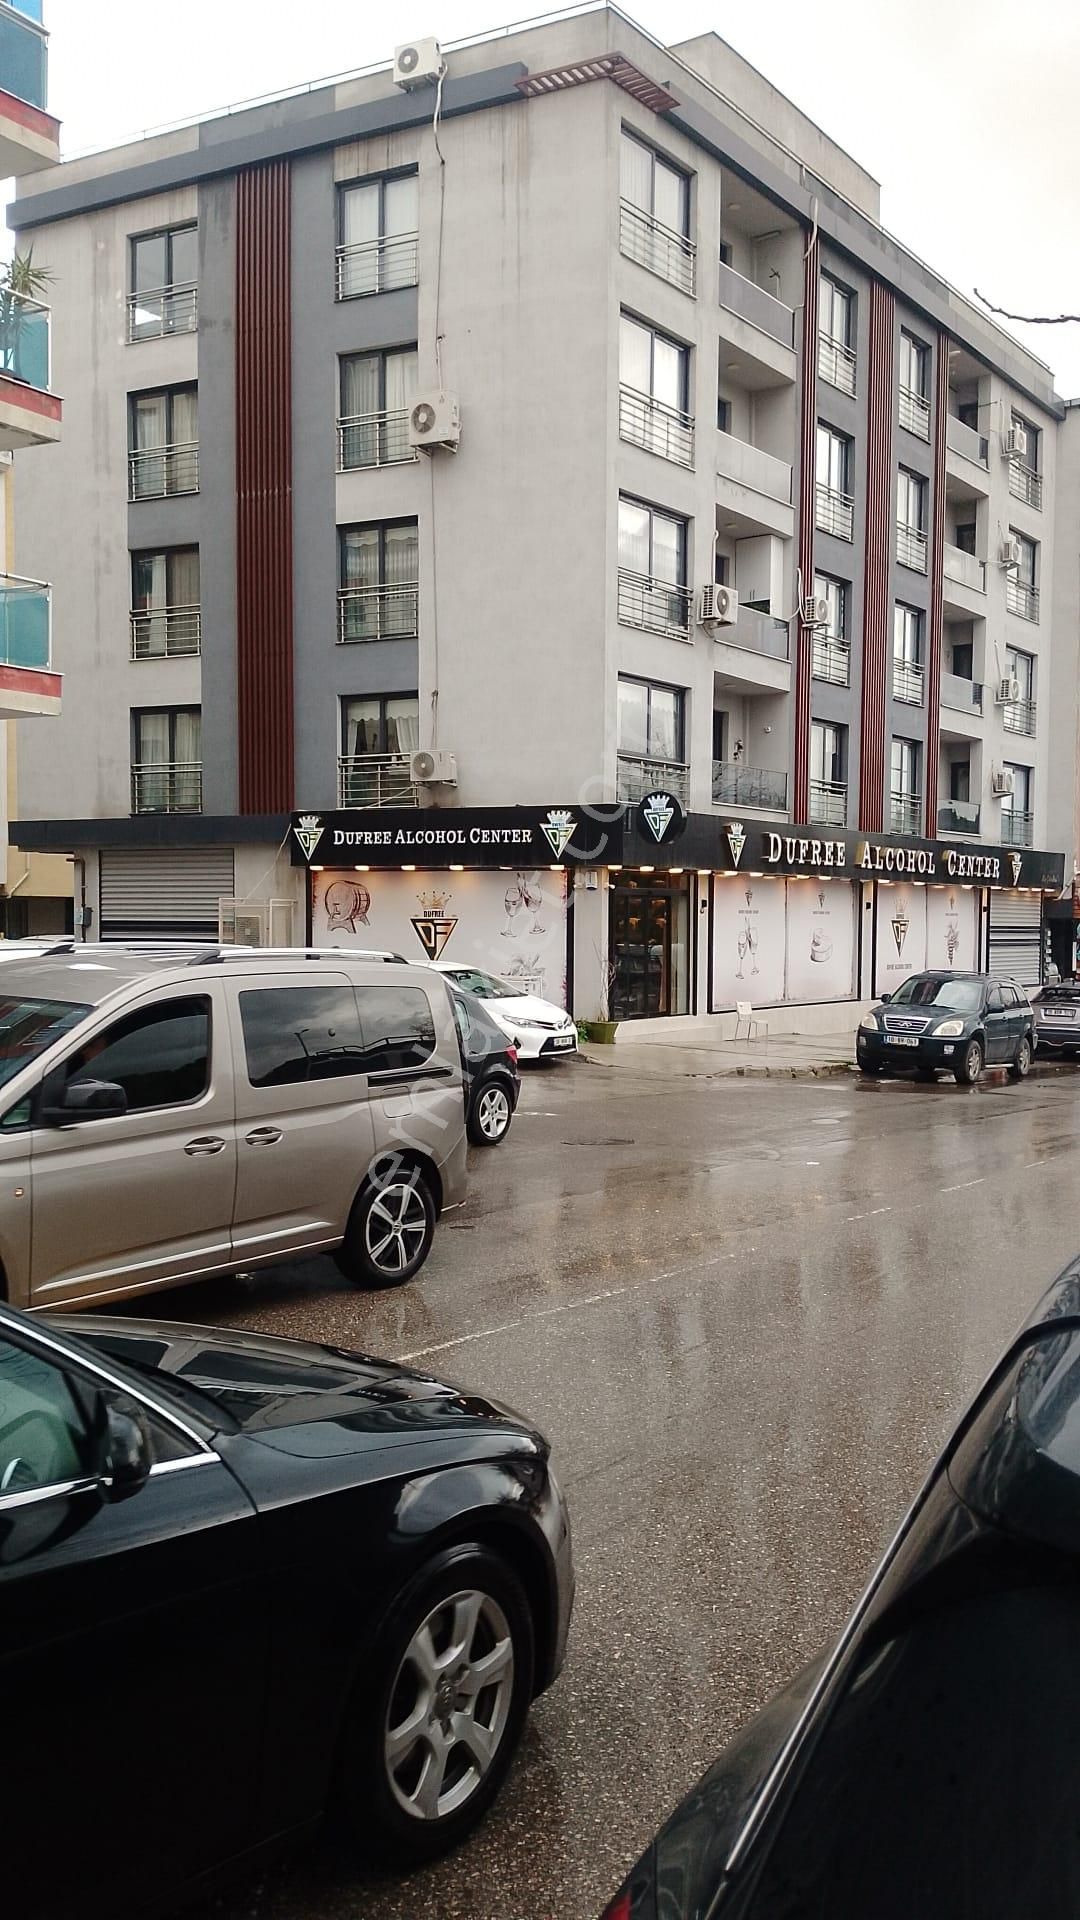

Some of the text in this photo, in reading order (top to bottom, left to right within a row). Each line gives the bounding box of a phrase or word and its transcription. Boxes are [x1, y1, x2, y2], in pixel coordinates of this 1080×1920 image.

[333, 828, 533, 845] DUFREE ALCOHOL CENTER
[768, 833, 846, 867] DUFREE
[861, 841, 936, 875] ALCOHOL
[947, 849, 1000, 879] CENTER
